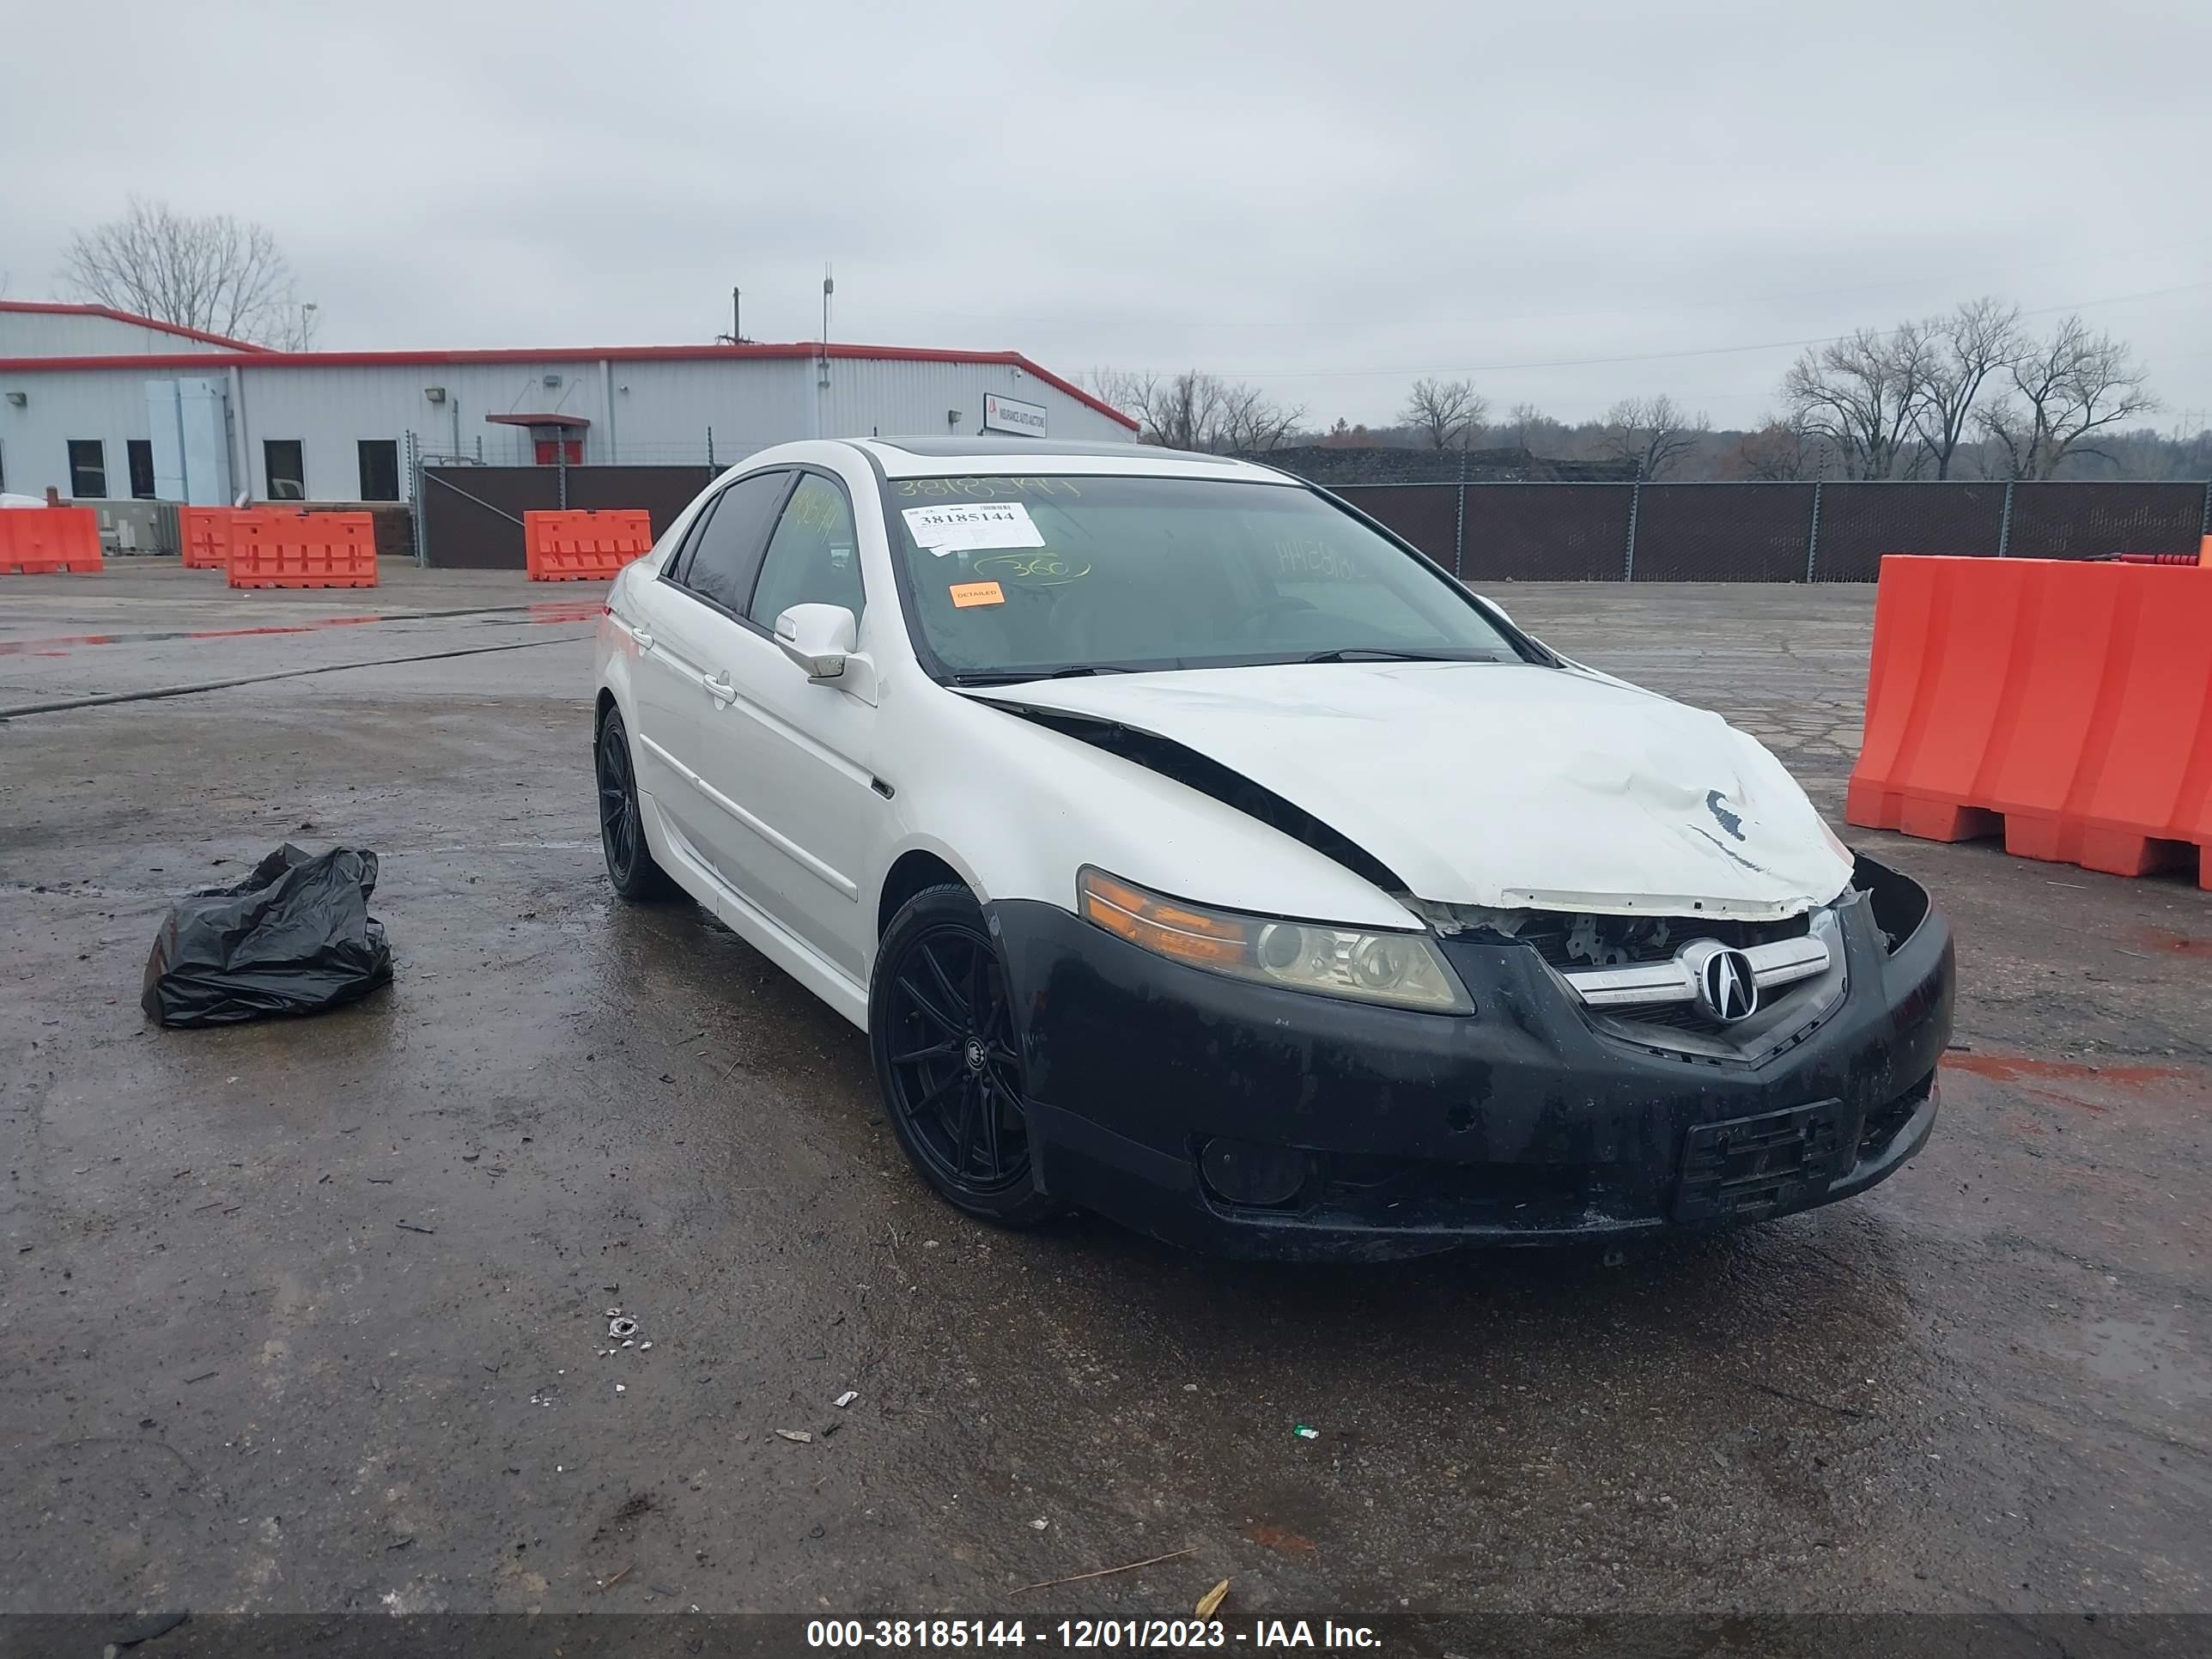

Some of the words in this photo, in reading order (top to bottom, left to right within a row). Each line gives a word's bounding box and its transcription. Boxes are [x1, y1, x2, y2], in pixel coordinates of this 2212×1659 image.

[1000, 407, 1019, 422] INSURANCE
[1019, 412, 1029, 425] AUTO
[920, 512, 1015, 526] 38185144
[996, 559, 1070, 577] 360
[957, 590, 997, 599] DETAILED
